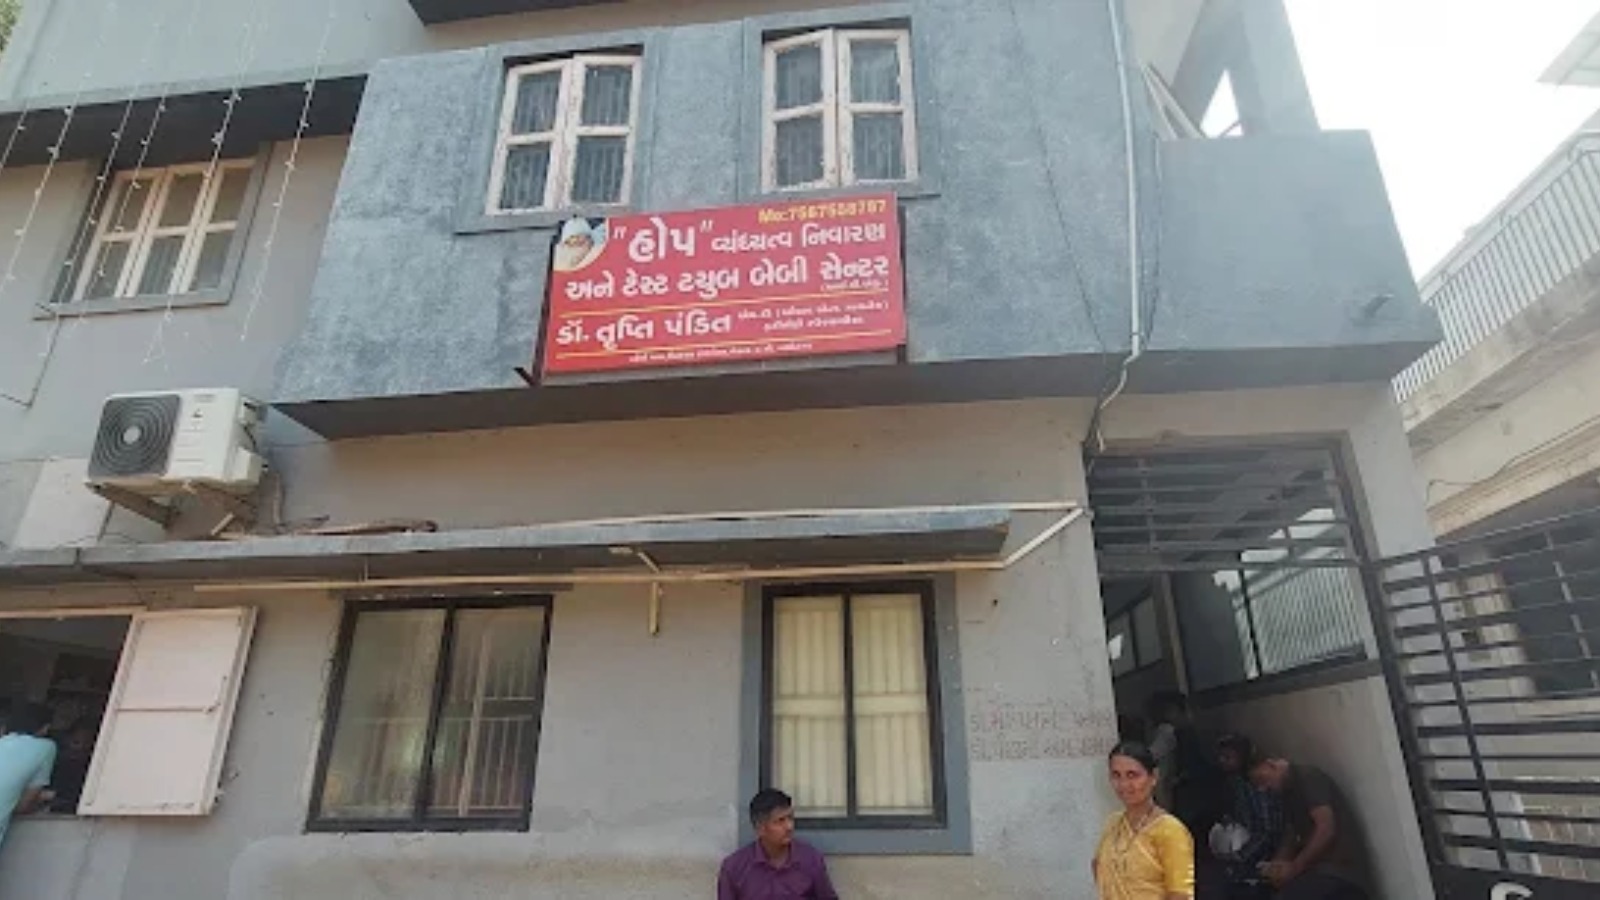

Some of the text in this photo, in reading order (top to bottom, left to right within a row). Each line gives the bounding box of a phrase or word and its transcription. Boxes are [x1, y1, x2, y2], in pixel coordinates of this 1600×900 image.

[801, 222, 887, 248] નિવારણ
[566, 274, 614, 301] અને
[622, 271, 671, 297] ટેસ્ટ
[750, 257, 806, 286] બેબી
[820, 252, 890, 279] સેન્ટર
[596, 315, 655, 351] તૃપ્તિ
[664, 311, 732, 337] પંડિત
